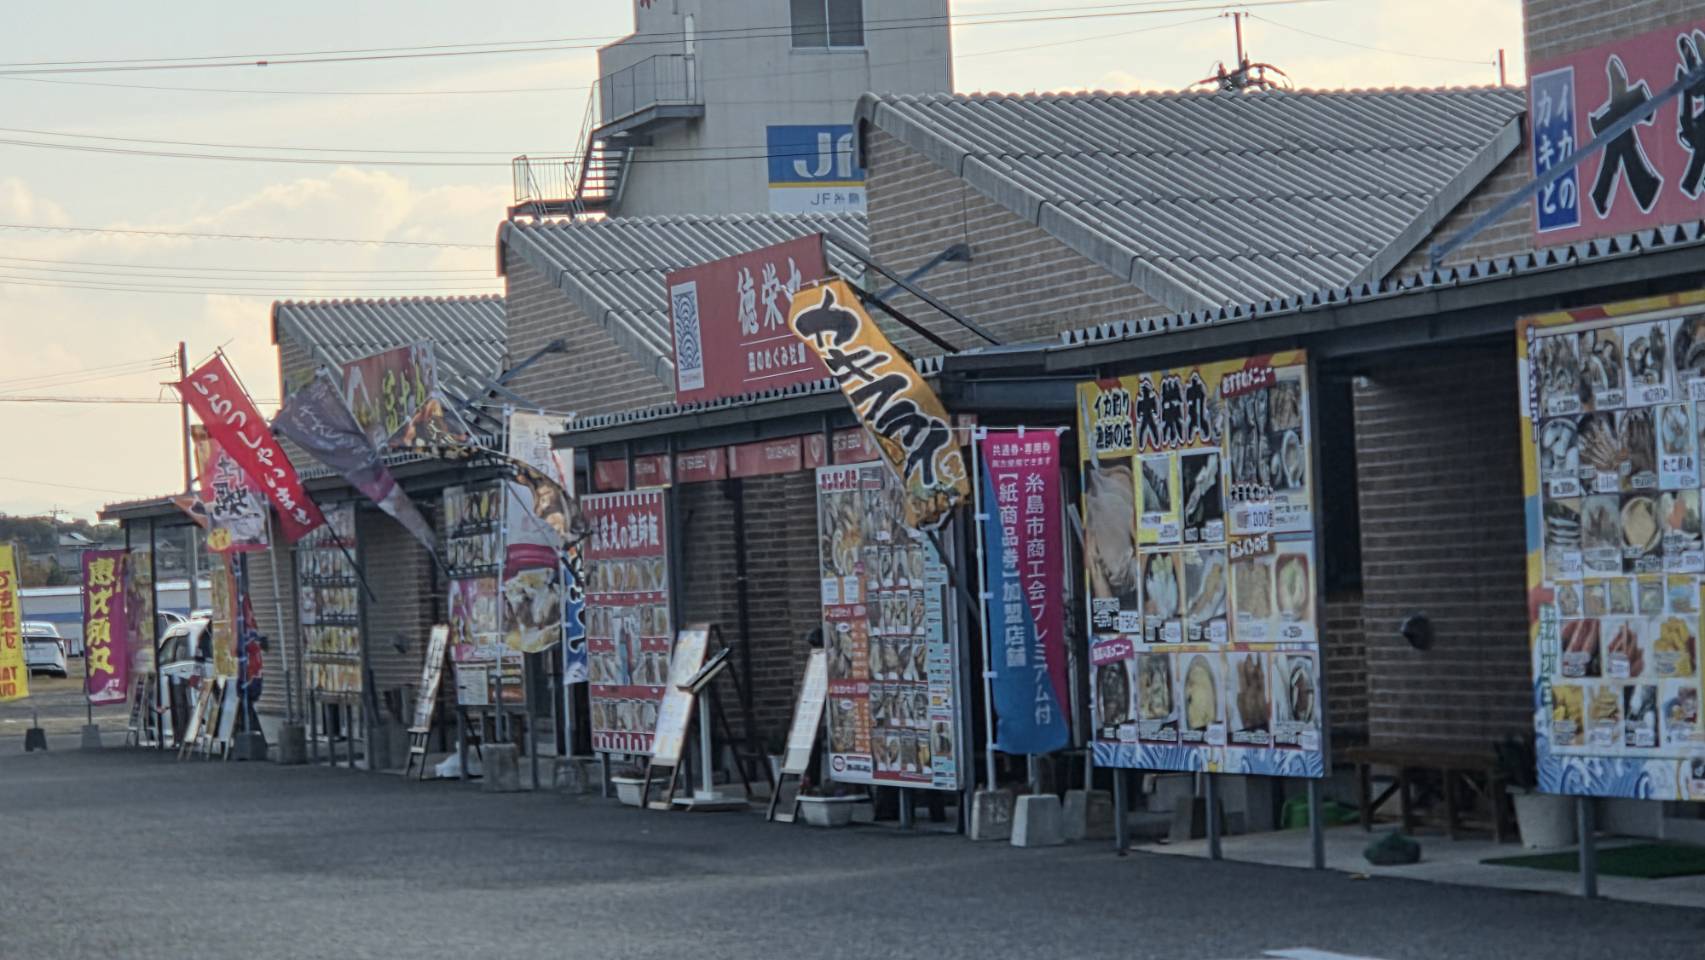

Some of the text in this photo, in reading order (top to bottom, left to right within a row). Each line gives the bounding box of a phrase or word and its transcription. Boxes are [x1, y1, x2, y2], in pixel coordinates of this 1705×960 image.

[1536, 88, 1556, 214] カキと
[1556, 85, 1576, 210] イカの
[192, 373, 311, 525] いらっしゃいませ
[794, 286, 951, 488] カキフライ
[1025, 473, 1051, 725] 糸島市商工会プレミアム付
